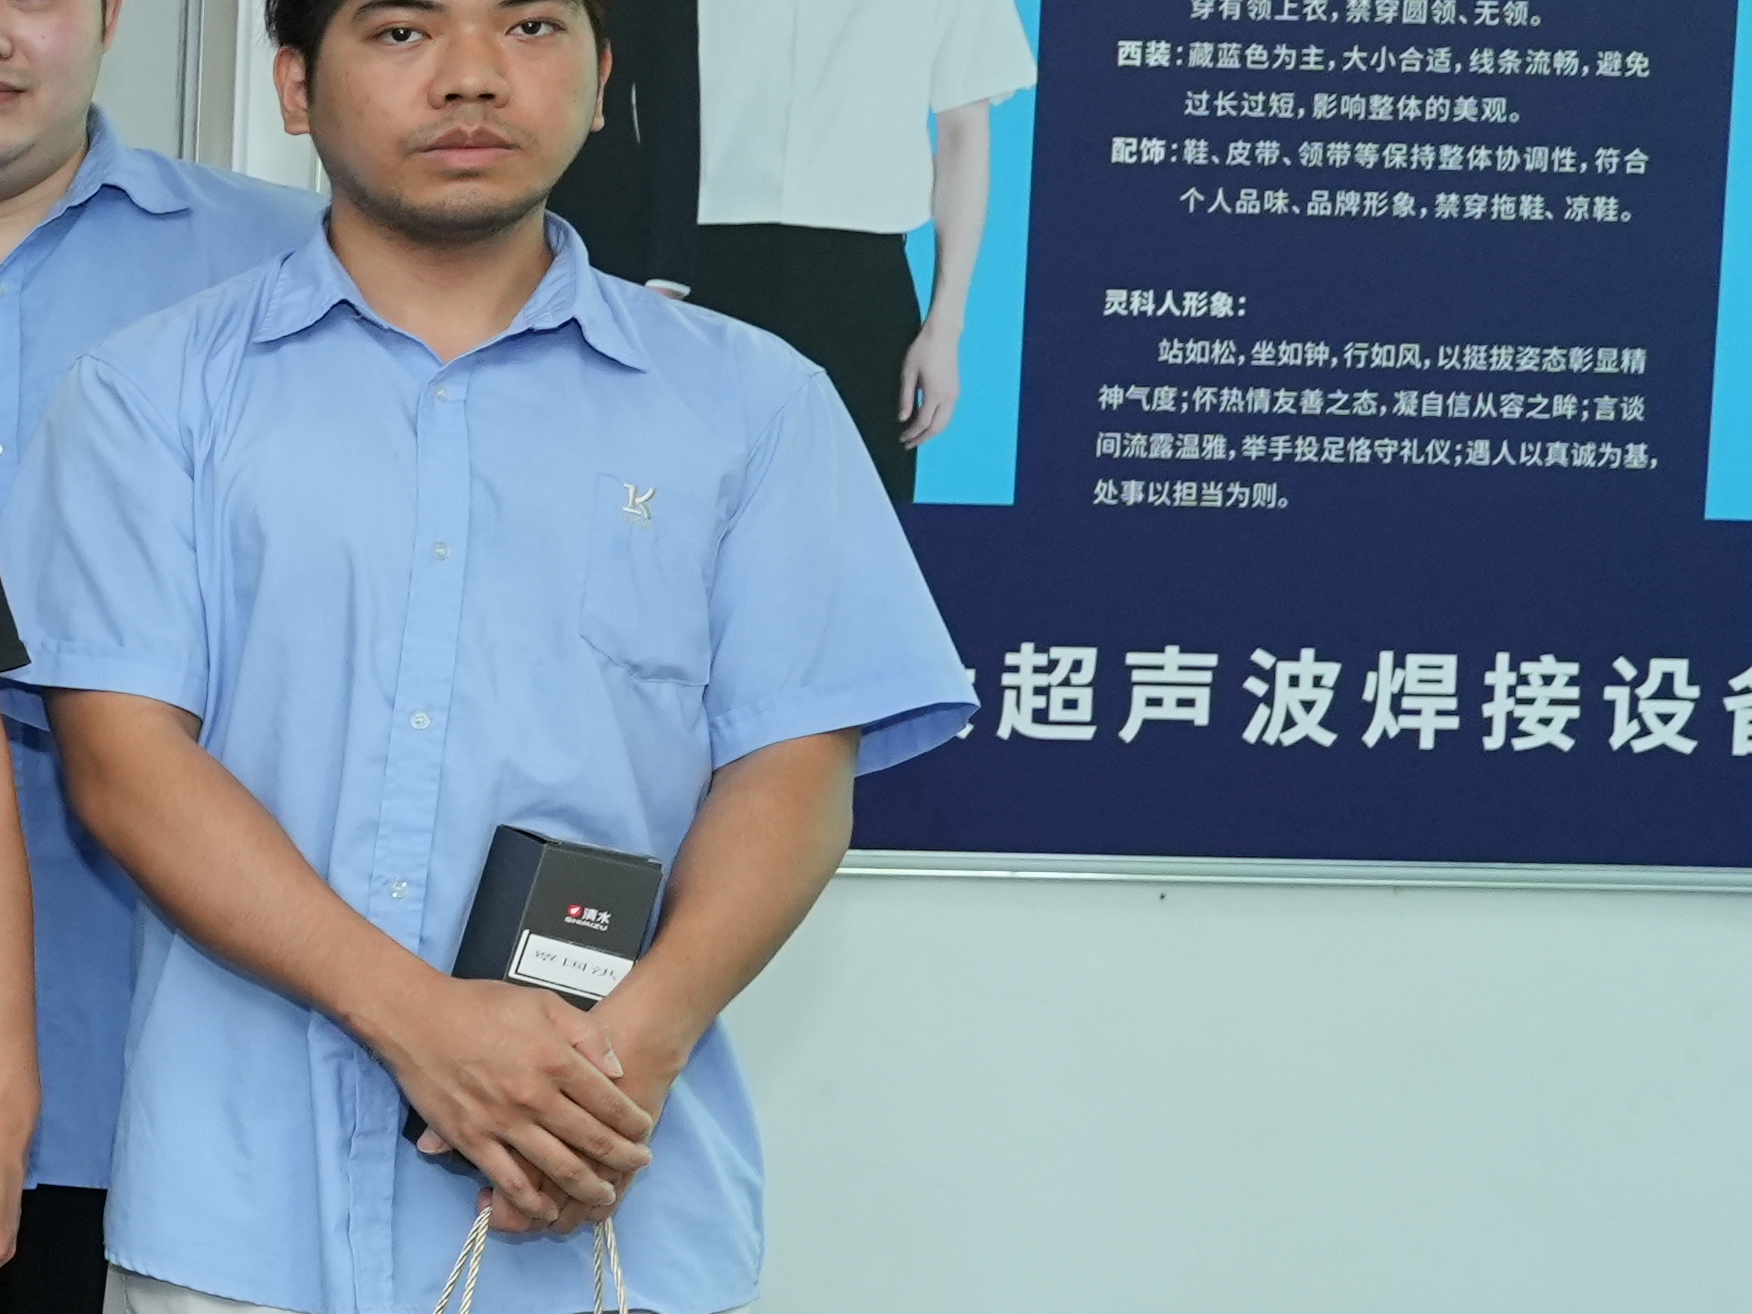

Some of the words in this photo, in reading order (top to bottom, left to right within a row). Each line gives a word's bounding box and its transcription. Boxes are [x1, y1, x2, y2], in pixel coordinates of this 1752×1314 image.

[1184, 90, 1519, 123] 过长过短，影响整体的美观。
[1104, 289, 1246, 318] 灵科人形象：
[1093, 479, 1288, 508] 处事以担当为则。
[956, 642, 1752, 756] 超声波焊接设
[582, 907, 612, 924] 清水
